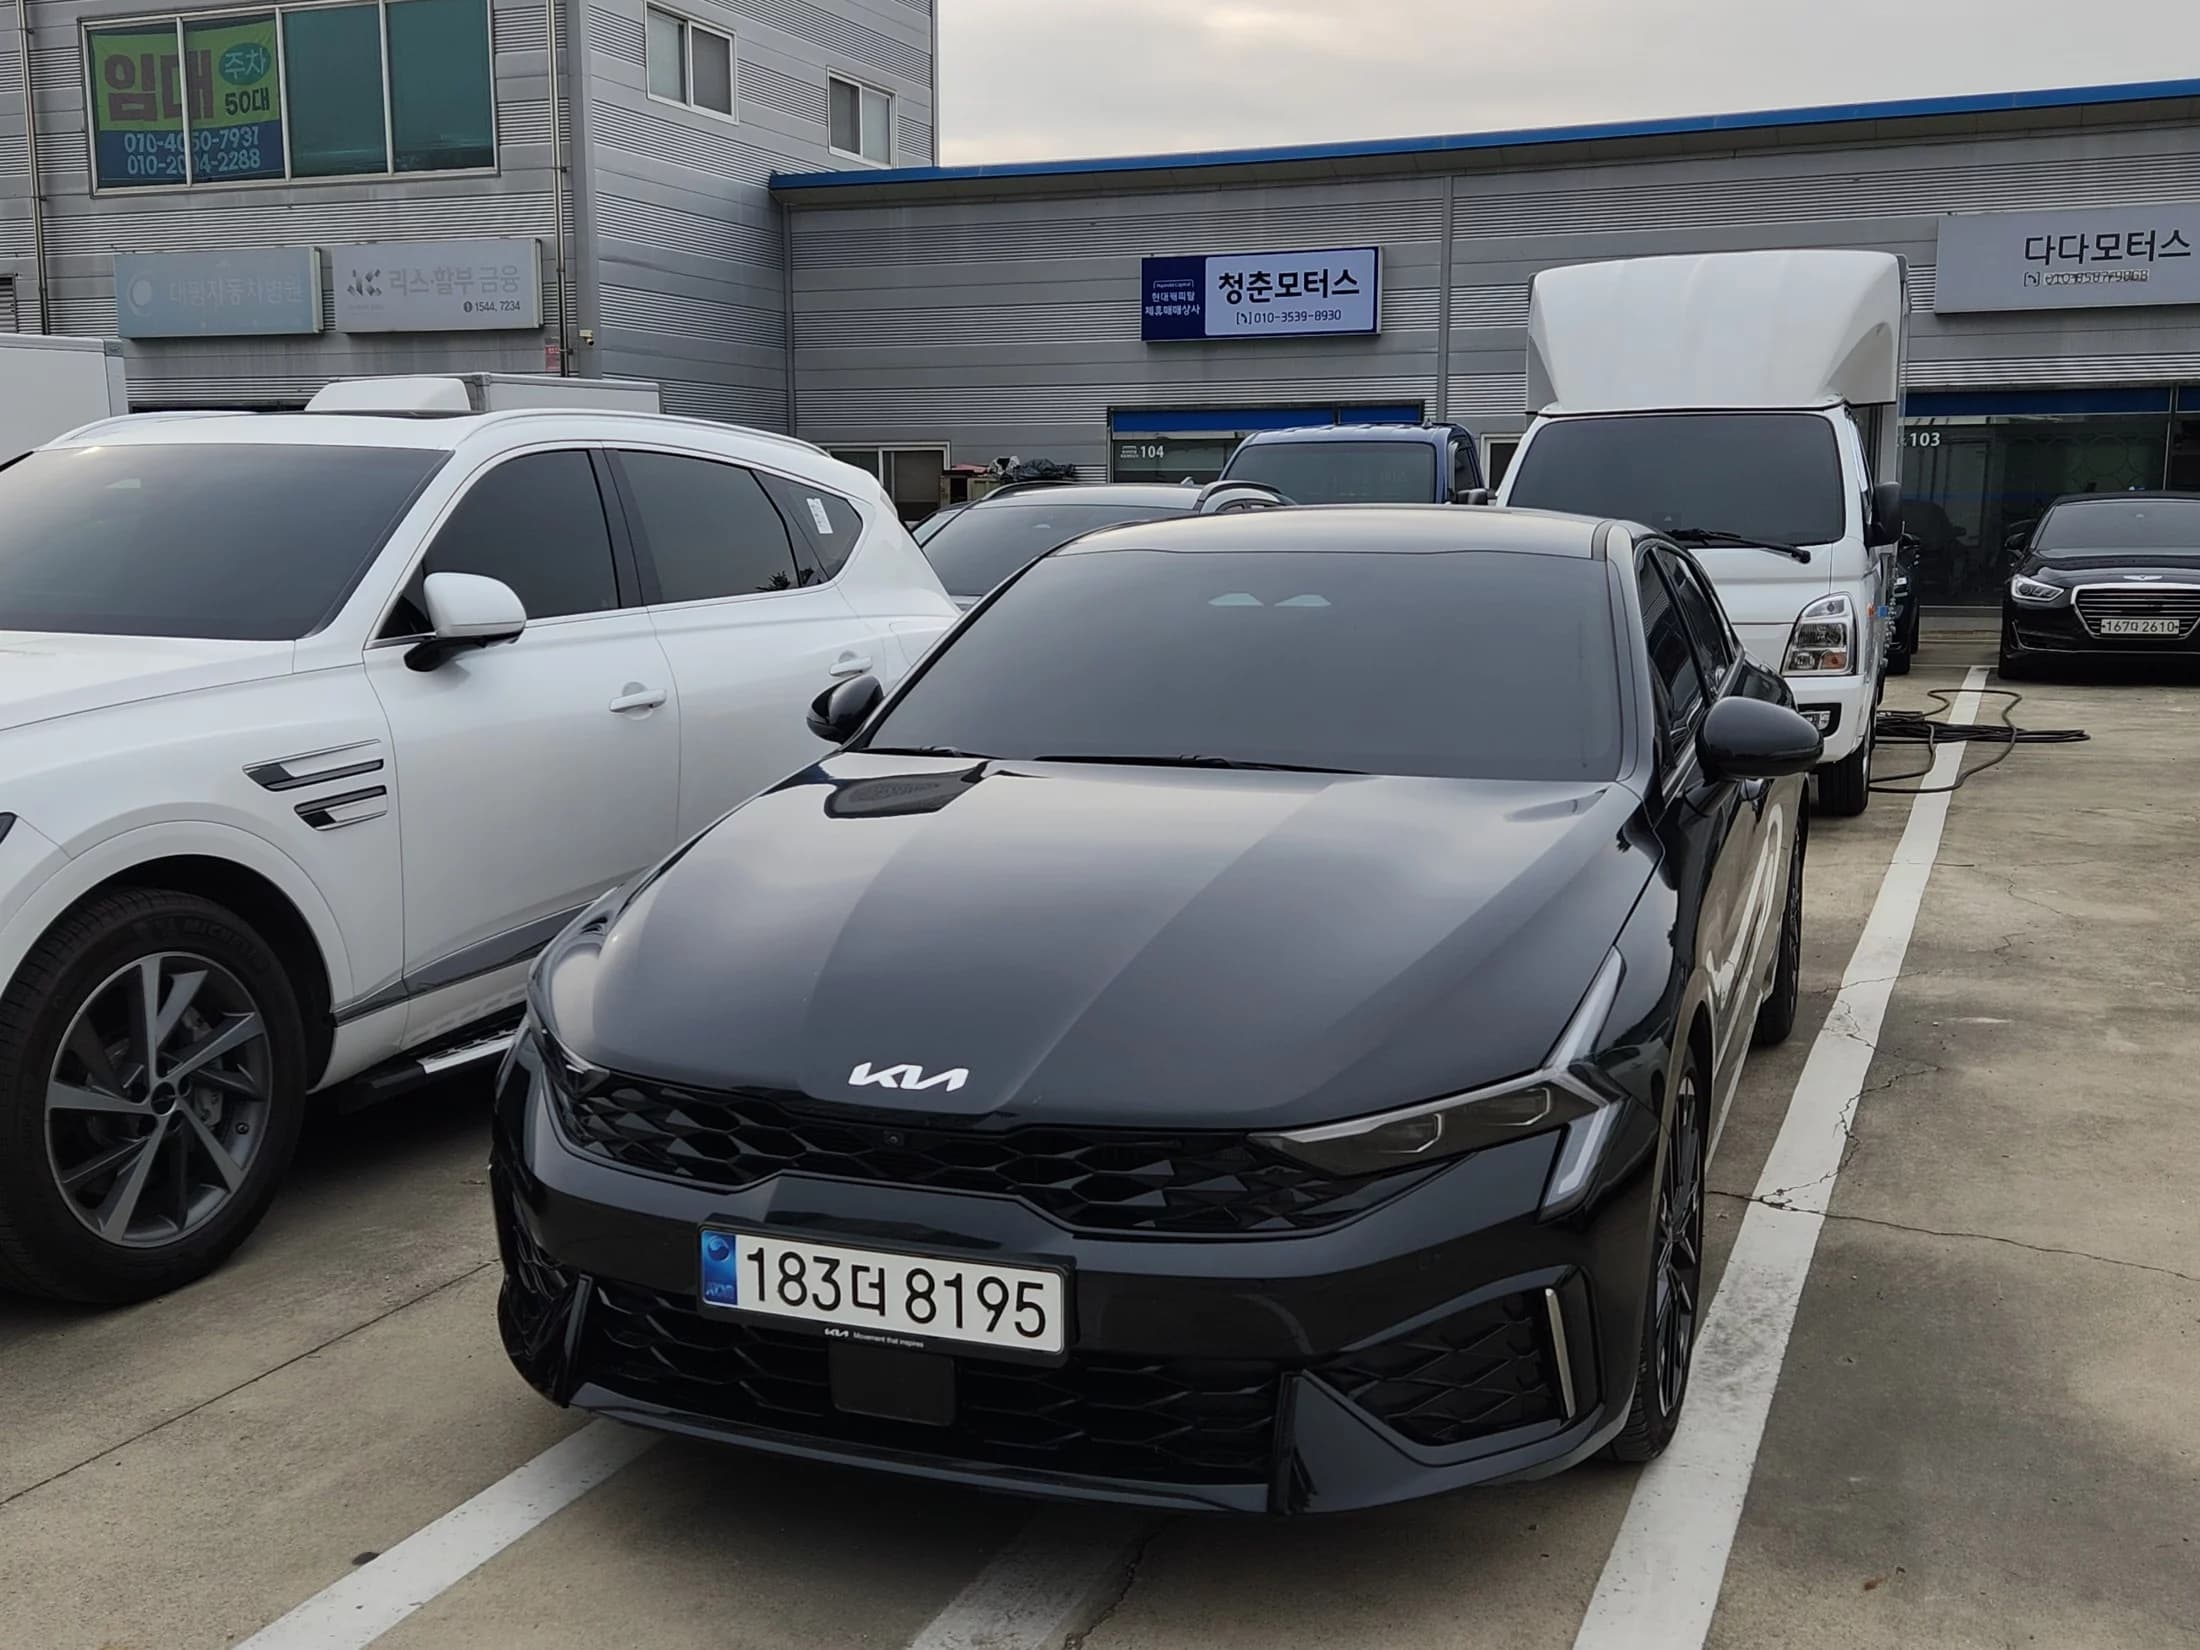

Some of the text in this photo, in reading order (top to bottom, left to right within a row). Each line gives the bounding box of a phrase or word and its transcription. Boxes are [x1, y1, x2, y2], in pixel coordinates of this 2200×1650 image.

[225, 48, 266, 80] 주차
[104, 50, 214, 122] 임대
[225, 87, 270, 116] 50대
[2025, 229, 2191, 266] 다다모터스
[477, 264, 521, 294] 금융
[1218, 268, 1360, 305] 청춘모터스
[1254, 309, 1342, 325] 010-3539-8930
[1140, 444, 1164, 459] 104
[1909, 431, 1941, 447] 103
[2142, 621, 2175, 633] 2610
[848, 1061, 969, 1092] KIA
[746, 1247, 1047, 1339] 183더 8195
